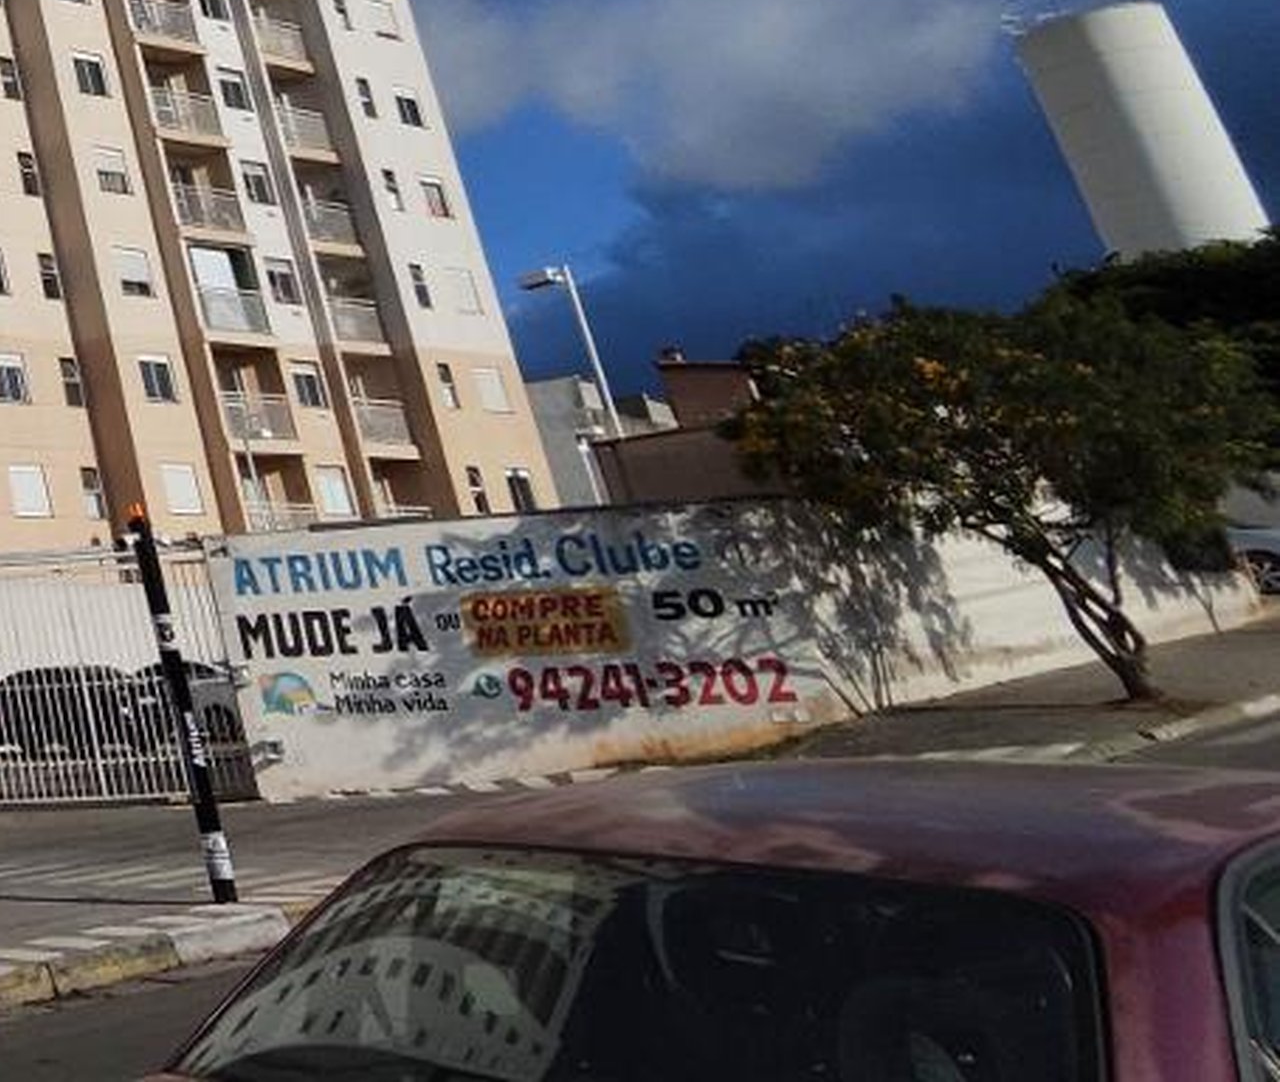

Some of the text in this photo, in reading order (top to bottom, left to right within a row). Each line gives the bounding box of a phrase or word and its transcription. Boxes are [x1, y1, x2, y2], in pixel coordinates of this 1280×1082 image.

[234, 529, 702, 596] ATRIUM Resid. Clube
[471, 593, 606, 624] COMPRE
[651, 587, 726, 621] 50
[236, 607, 358, 660] MUDE
[370, 595, 430, 655] JÁ
[477, 621, 620, 650] NA PLANTA
[330, 671, 447, 689] Minha casa
[507, 656, 799, 711] 94241-3202
[333, 692, 449, 715] Minha vida
